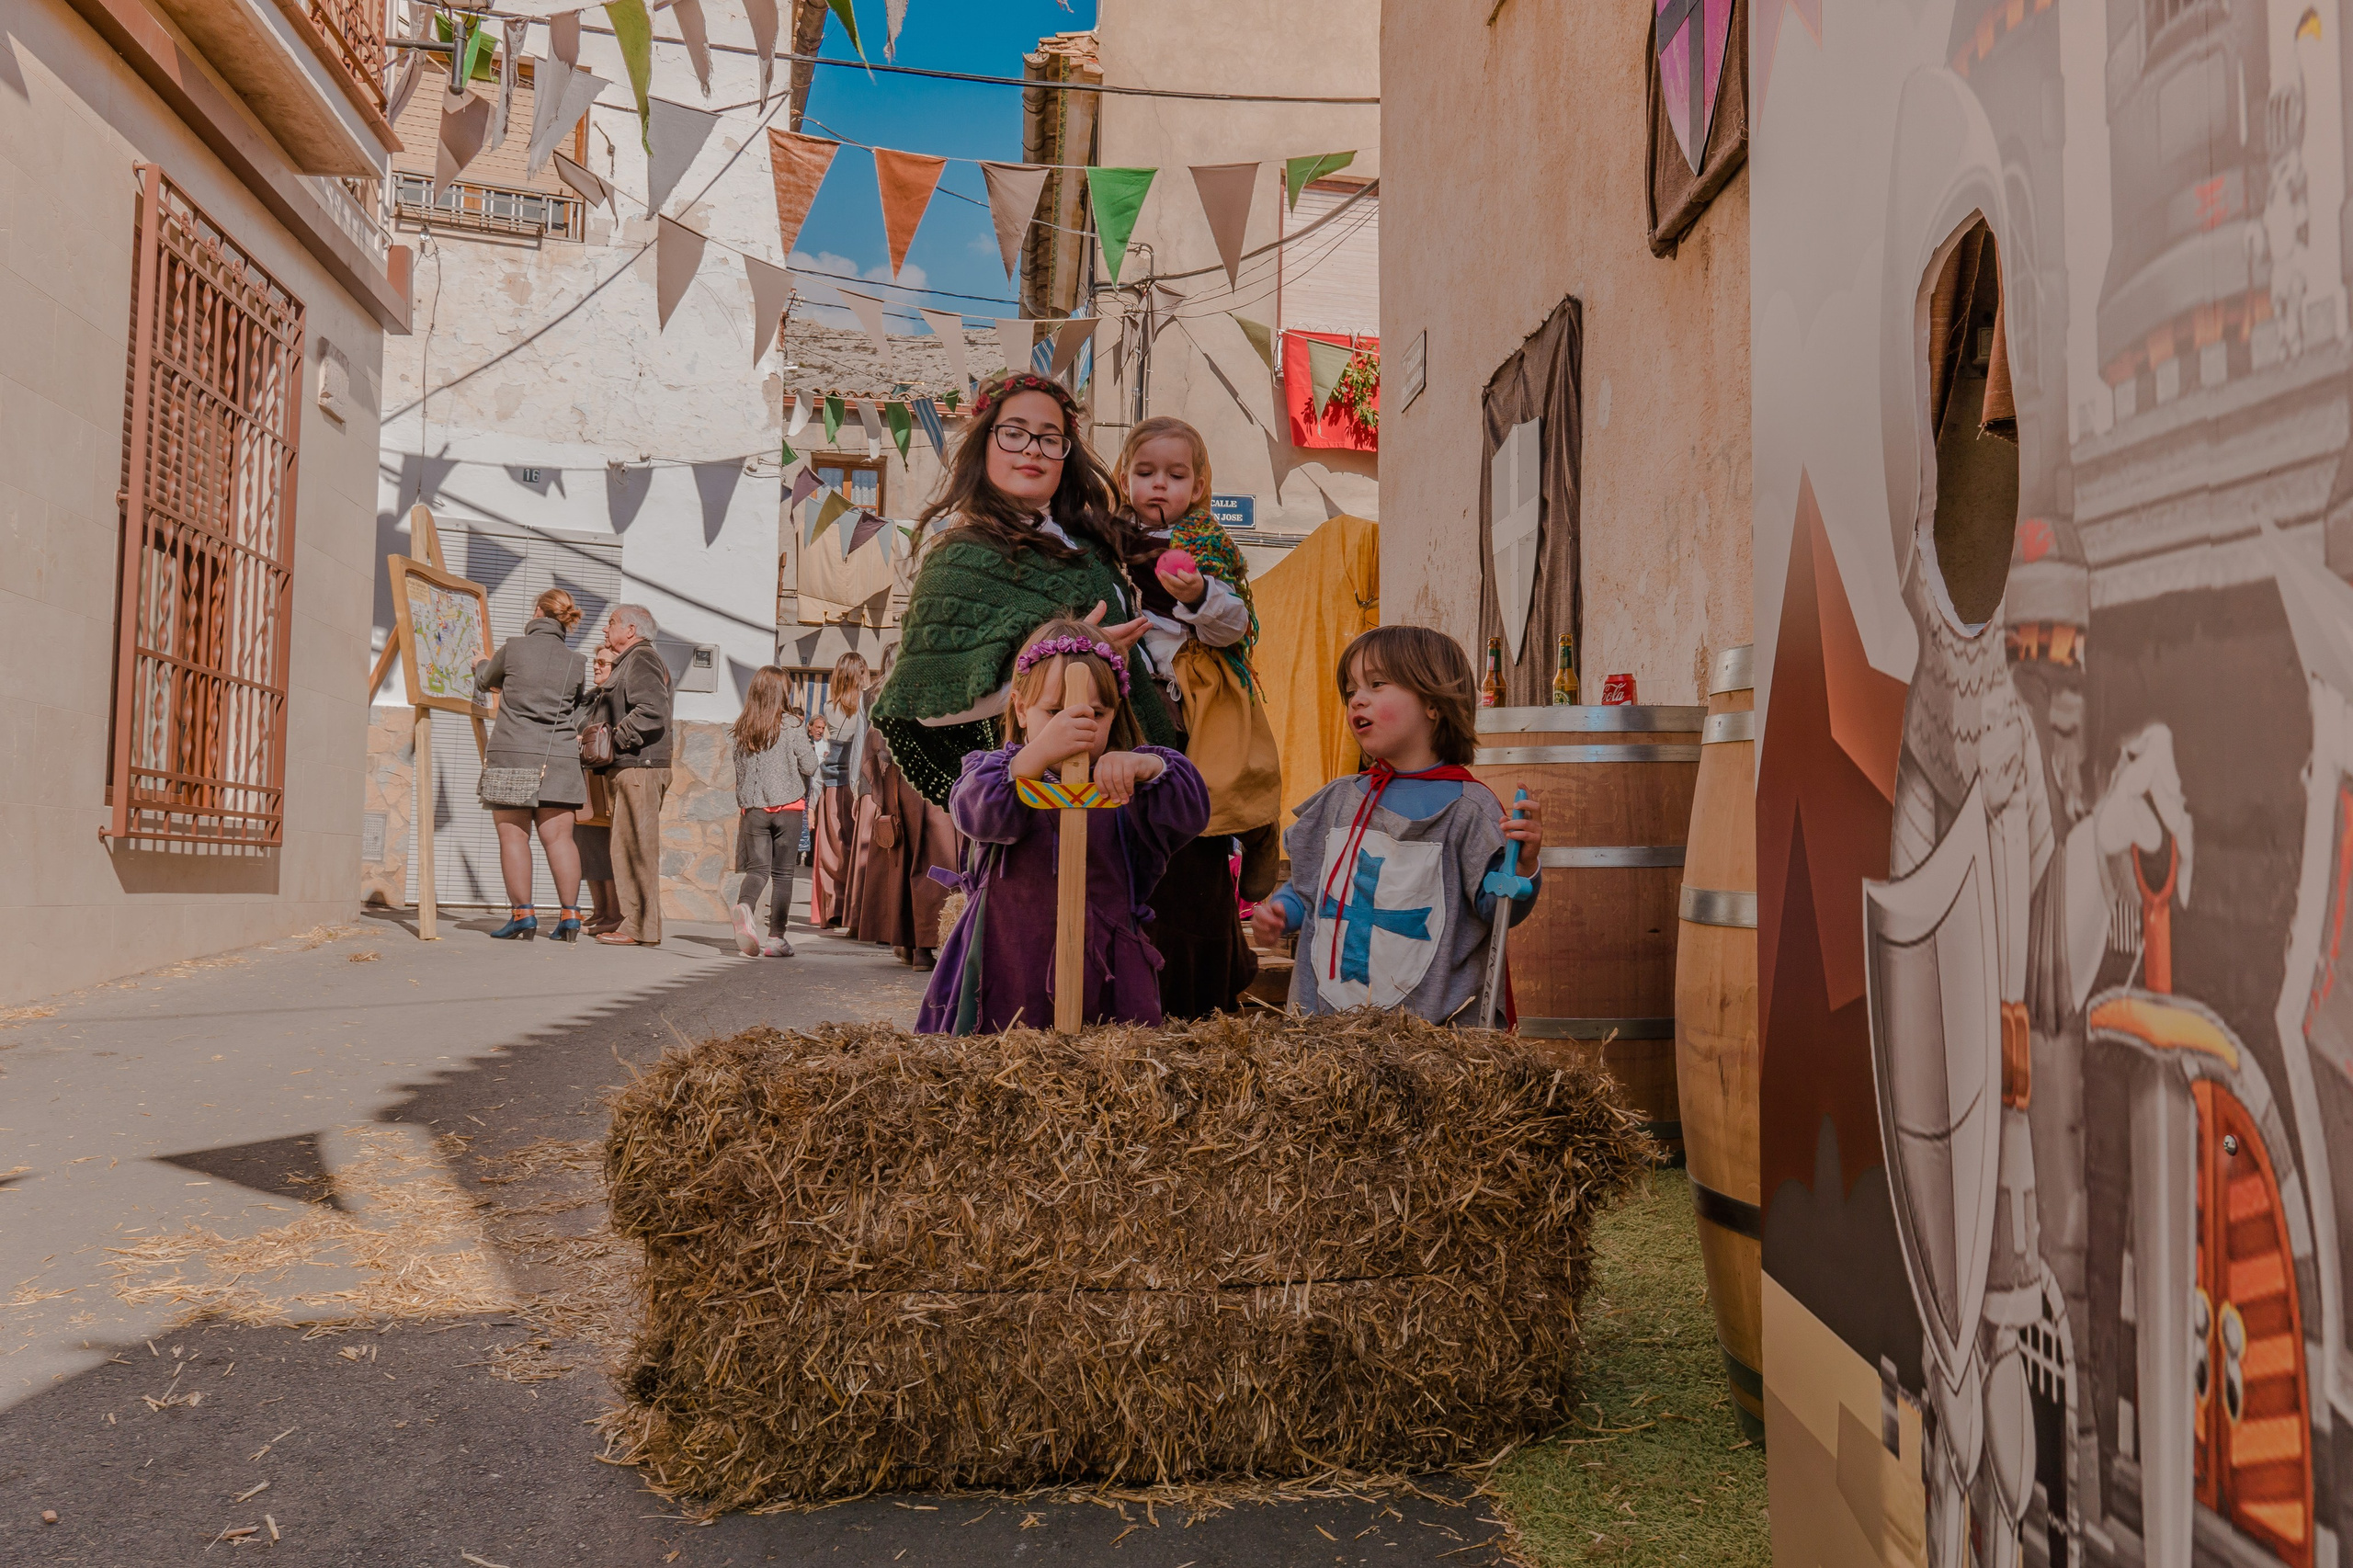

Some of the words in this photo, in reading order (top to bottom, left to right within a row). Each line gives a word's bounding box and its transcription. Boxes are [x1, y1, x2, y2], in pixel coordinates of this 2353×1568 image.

[525, 468, 540, 483] 16
[1211, 499, 1237, 508] CALLE
[1221, 513, 1243, 522] JOSE
